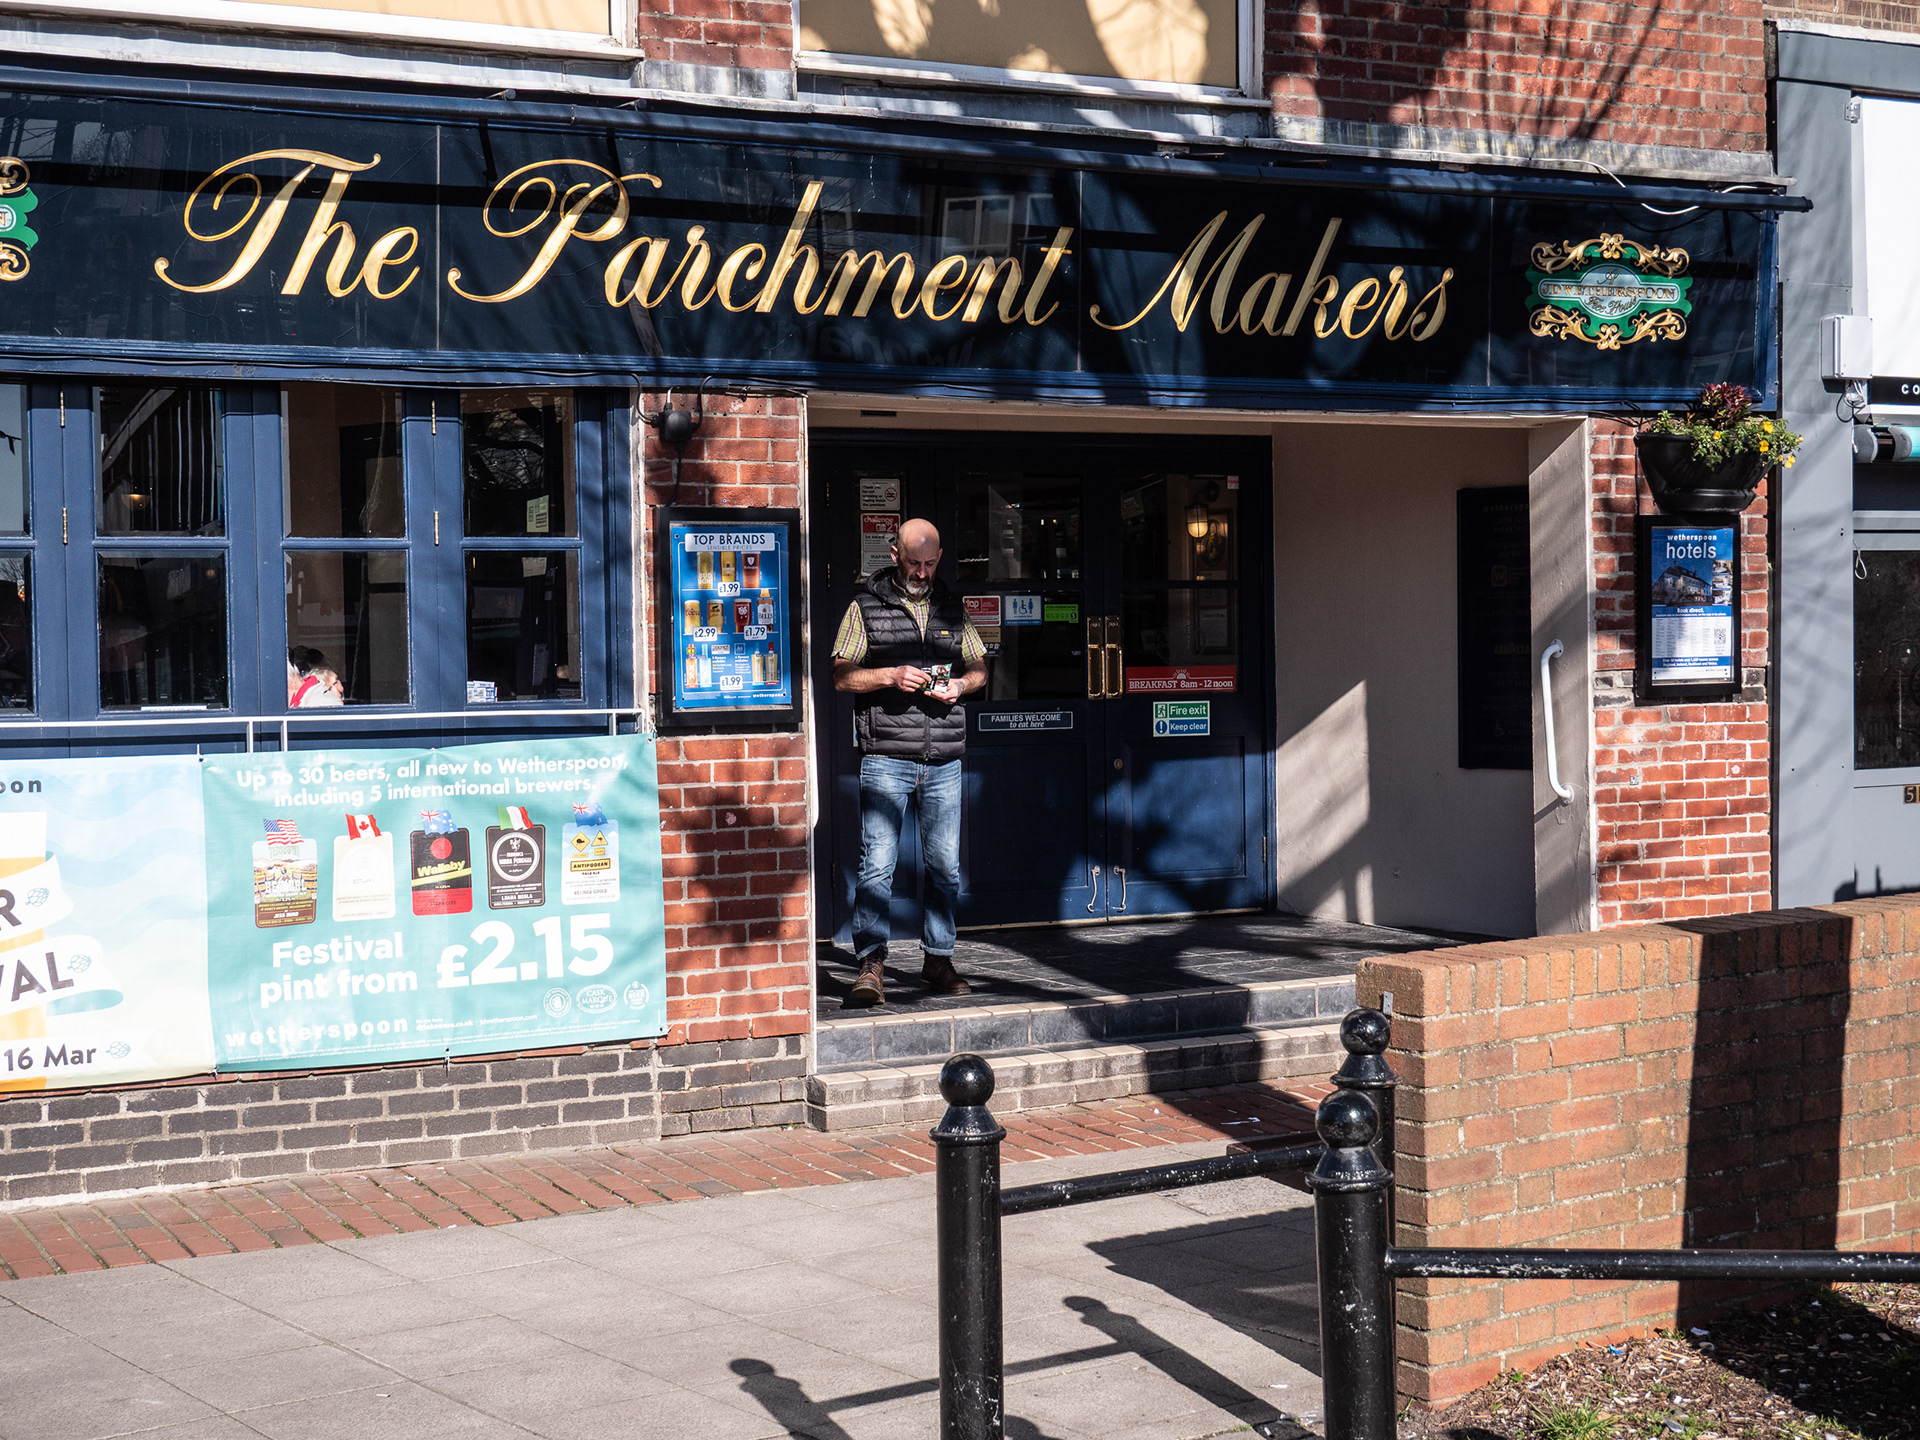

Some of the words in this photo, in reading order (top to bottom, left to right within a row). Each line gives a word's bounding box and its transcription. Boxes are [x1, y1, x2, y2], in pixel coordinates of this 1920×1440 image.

[154, 149, 420, 299] The
[448, 159, 1073, 326] Parchment
[1091, 210, 1454, 341] Makers
[864, 516, 894, 525] challenge
[887, 523, 899, 533] 21
[693, 535, 715, 545] TOP
[720, 534, 766, 545] BRANDS
[1667, 534, 1717, 542] wetherspoon
[1666, 542, 1717, 559] hotels
[719, 584, 739, 593] £1.99
[695, 628, 716, 638] £2.99
[745, 627, 766, 636] £1.79
[722, 677, 741, 686] £1.99
[1129, 680, 1178, 689] BREAKFAST
[1180, 680, 1198, 688] 8am
[1204, 680, 1213, 688] 12
[1170, 706, 1188, 715] Fire
[1188, 706, 1206, 715] exit
[991, 715, 1024, 724] FAMILIES
[1024, 713, 1061, 722] WELCOME
[1030, 720, 1045, 728] here
[1170, 723, 1188, 732] Keep
[1189, 722, 1207, 731] clear
[236, 770, 266, 792] Up
[272, 771, 293, 786] to
[299, 767, 325, 785] 30
[330, 765, 391, 783] beers,
[397, 760, 420, 778] all
[426, 760, 468, 776] new
[474, 760, 493, 775] to
[497, 755, 629, 774] Wetherspoon,
[274, 787, 364, 808] including
[370, 785, 382, 802] 5
[387, 777, 510, 800] international
[515, 776, 597, 794] brewers.
[417, 860, 466, 877] Wallaby
[573, 861, 609, 869] ANTIPODEAN
[272, 932, 403, 968] Festival
[436, 914, 615, 989] £2.15
[260, 973, 330, 1009] pint
[337, 969, 418, 996] from
[586, 988, 606, 997] CASK
[628, 991, 646, 1000] BEER
[416, 1019, 474, 1031] drinkaware.co.uk
[479, 1014, 538, 1026] jdwetherspoon.com
[225, 1018, 408, 1047] wetherspoon
[4, 1048, 34, 1072] 16
[43, 1044, 97, 1068] Mar
